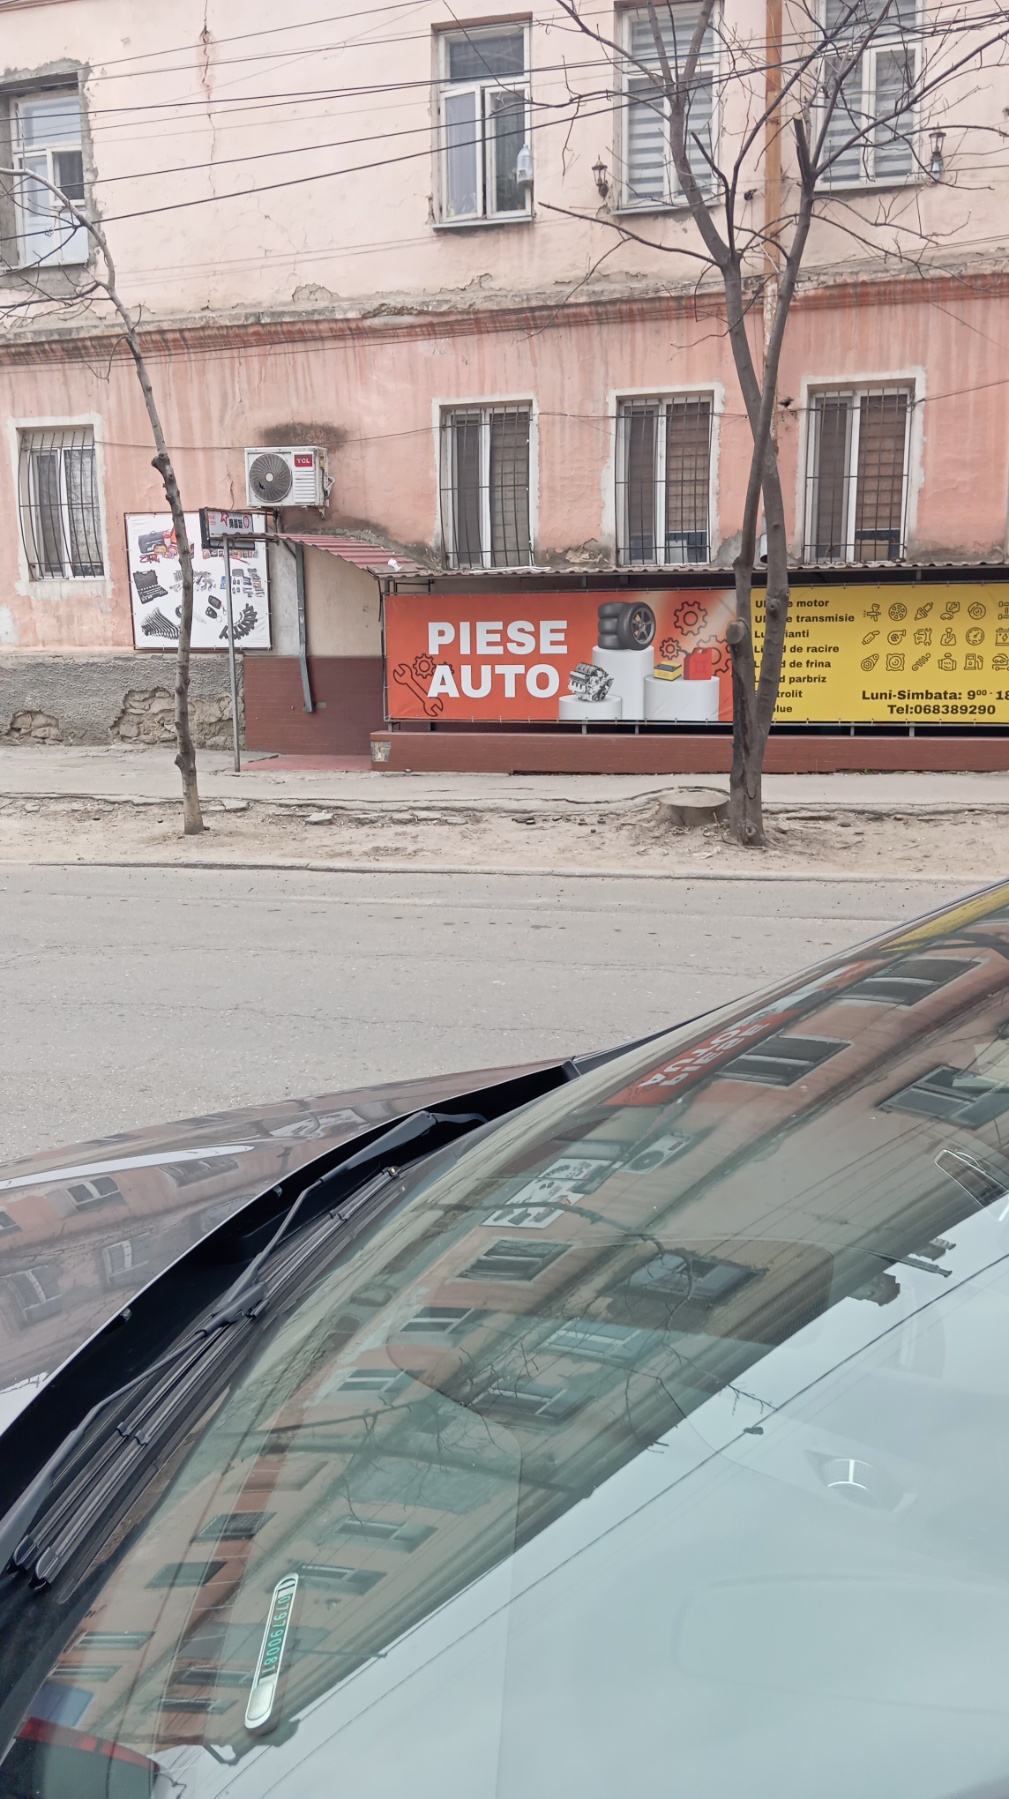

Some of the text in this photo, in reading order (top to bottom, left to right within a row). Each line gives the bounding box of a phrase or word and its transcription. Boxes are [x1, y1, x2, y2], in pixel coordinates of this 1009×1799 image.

[796, 599, 830, 608] motor
[796, 614, 855, 623] transmisie
[428, 620, 568, 655] PIESE
[790, 645, 803, 653] de
[806, 644, 839, 653] racire
[789, 660, 802, 668] de
[806, 659, 831, 668] frina
[427, 663, 560, 698] AUTO
[789, 674, 827, 684] parbriz
[861, 689, 962, 700] Luni-Simbata:
[887, 704, 996, 715] Tel:068389290
[261, 1595, 292, 1675] 079790081
